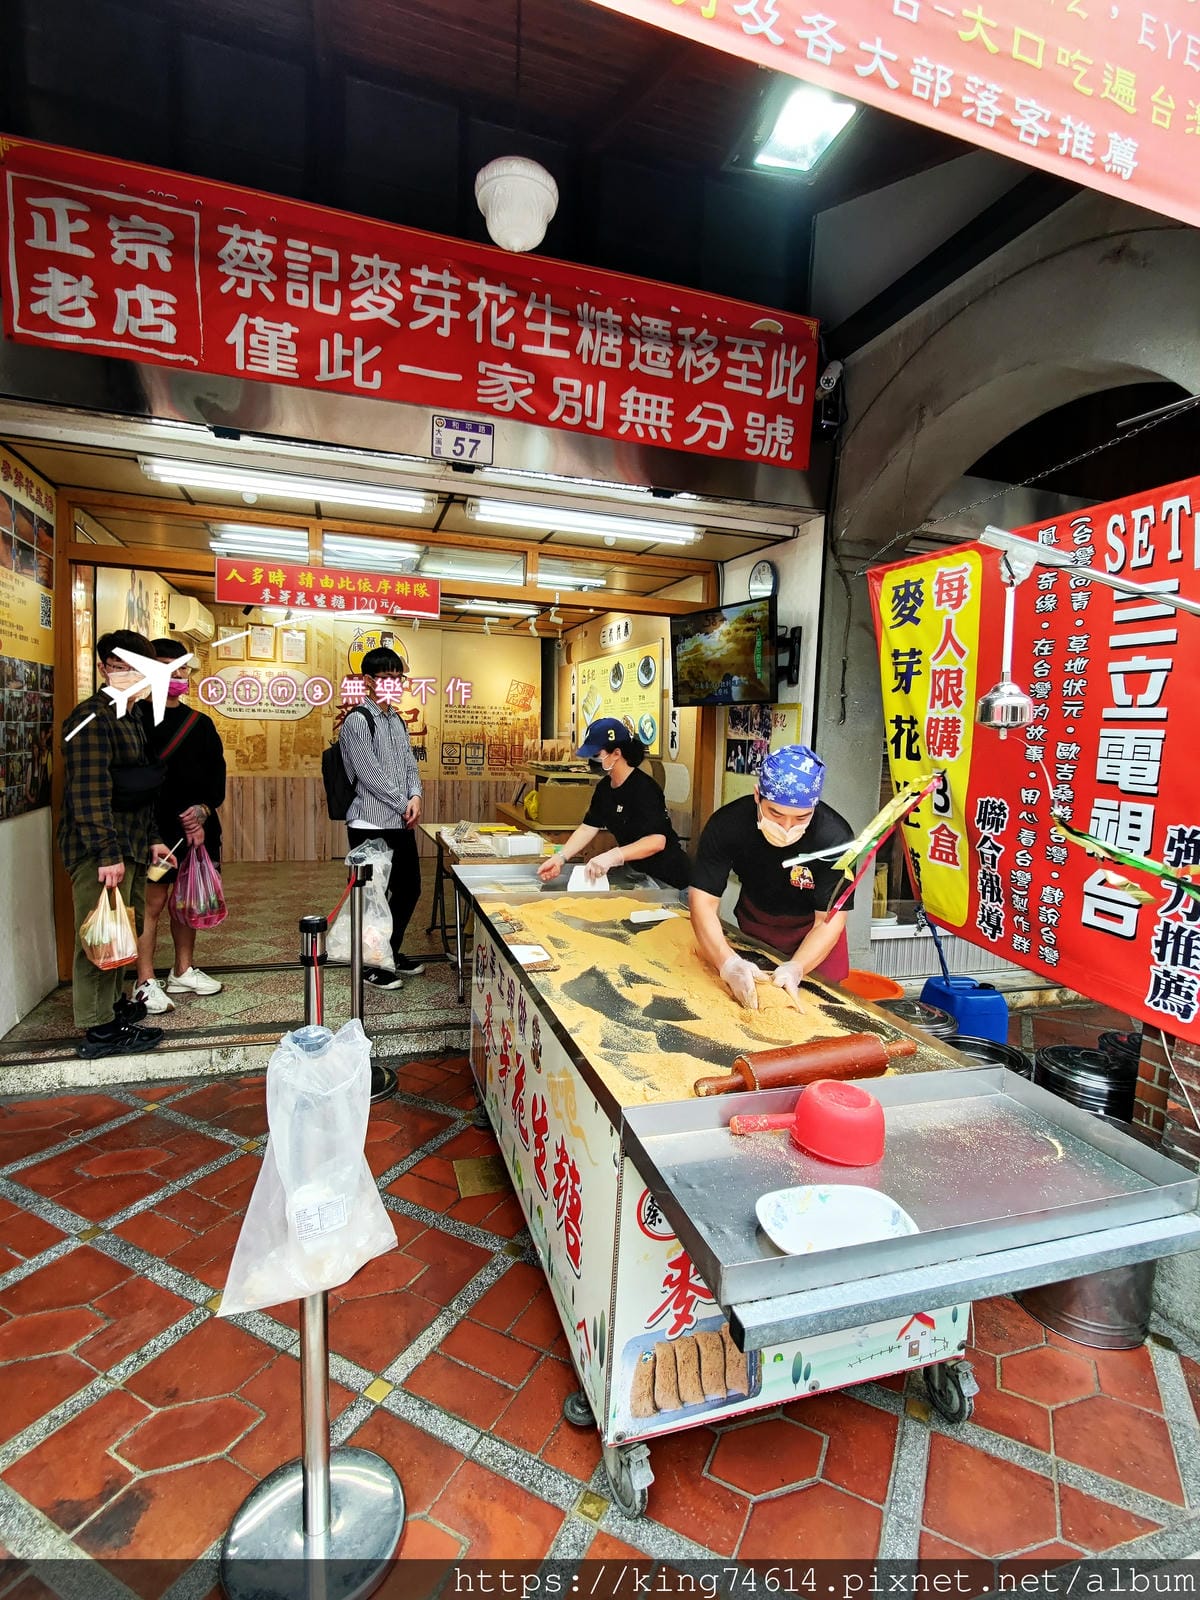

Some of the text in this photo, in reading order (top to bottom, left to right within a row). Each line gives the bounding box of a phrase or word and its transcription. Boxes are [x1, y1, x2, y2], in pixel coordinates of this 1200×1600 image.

[25, 196, 174, 273] 正宗
[29, 266, 178, 344] 老店
[216, 223, 808, 405] 蔡記麥芽花生糖遷移至此
[225, 313, 796, 462] 僅此一家別無分號
[452, 436, 481, 459] 57
[225, 567, 430, 598] 人多時 請由此依序排隊
[260, 588, 346, 609] 麥芽花生糖
[607, 730, 615, 741] 3
[927, 568, 970, 870] 每人限購3盒
[1081, 578, 1180, 940] 三立電視台
[976, 798, 1009, 940] 聯合報導
[1146, 825, 1200, 1022] 強力推薦
